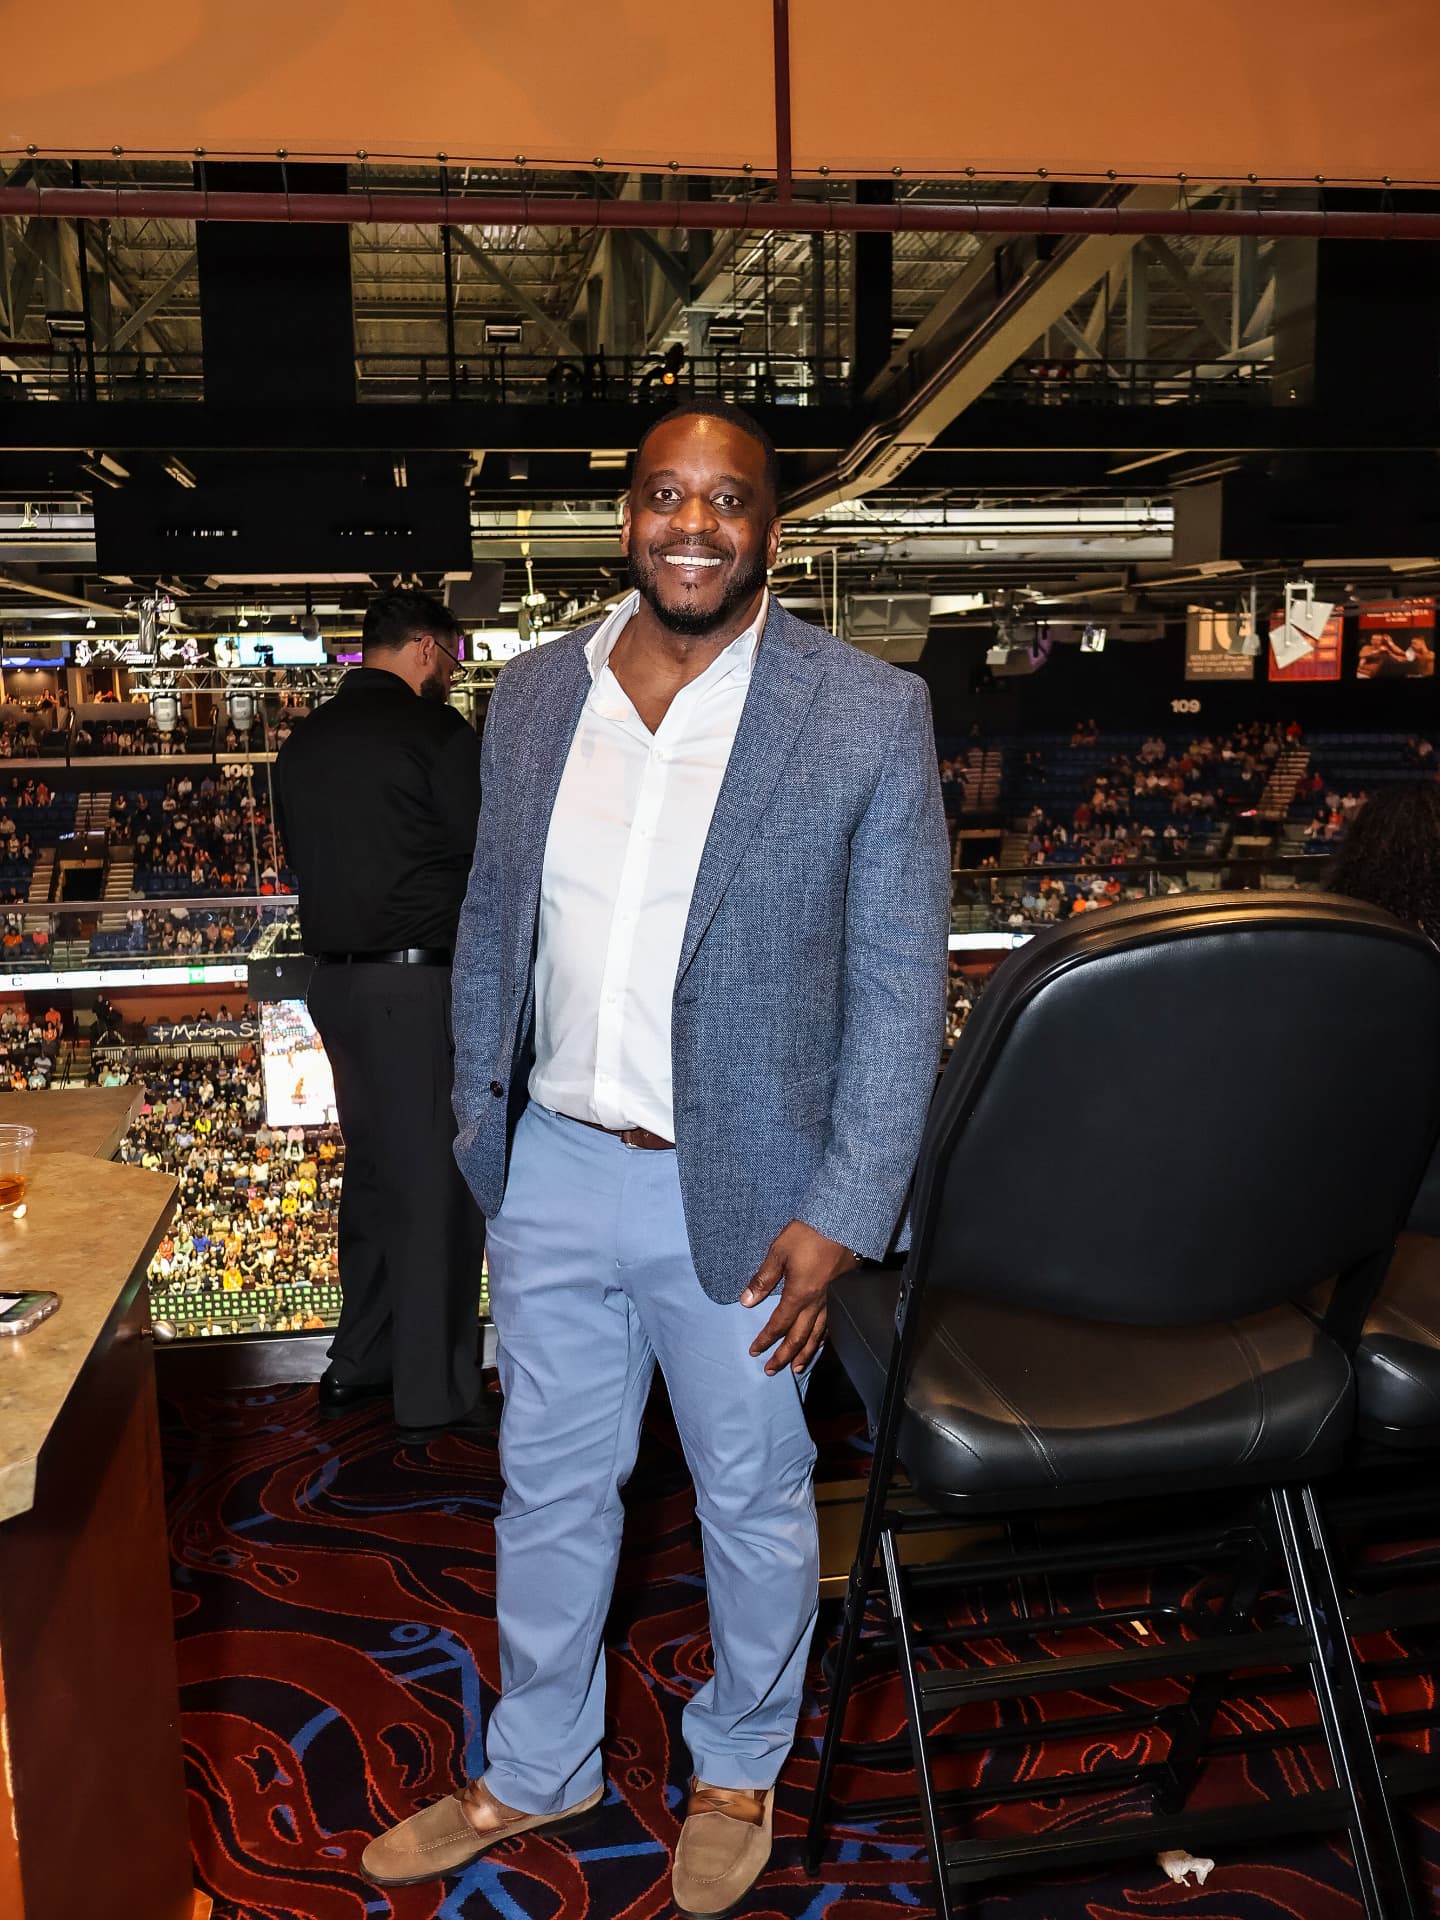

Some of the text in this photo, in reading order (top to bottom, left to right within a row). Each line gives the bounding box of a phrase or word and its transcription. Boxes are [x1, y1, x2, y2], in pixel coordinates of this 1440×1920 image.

[1170, 699, 1201, 713] 109
[222, 764, 254, 778] 106
[171, 1022, 237, 1041] Mohegan
